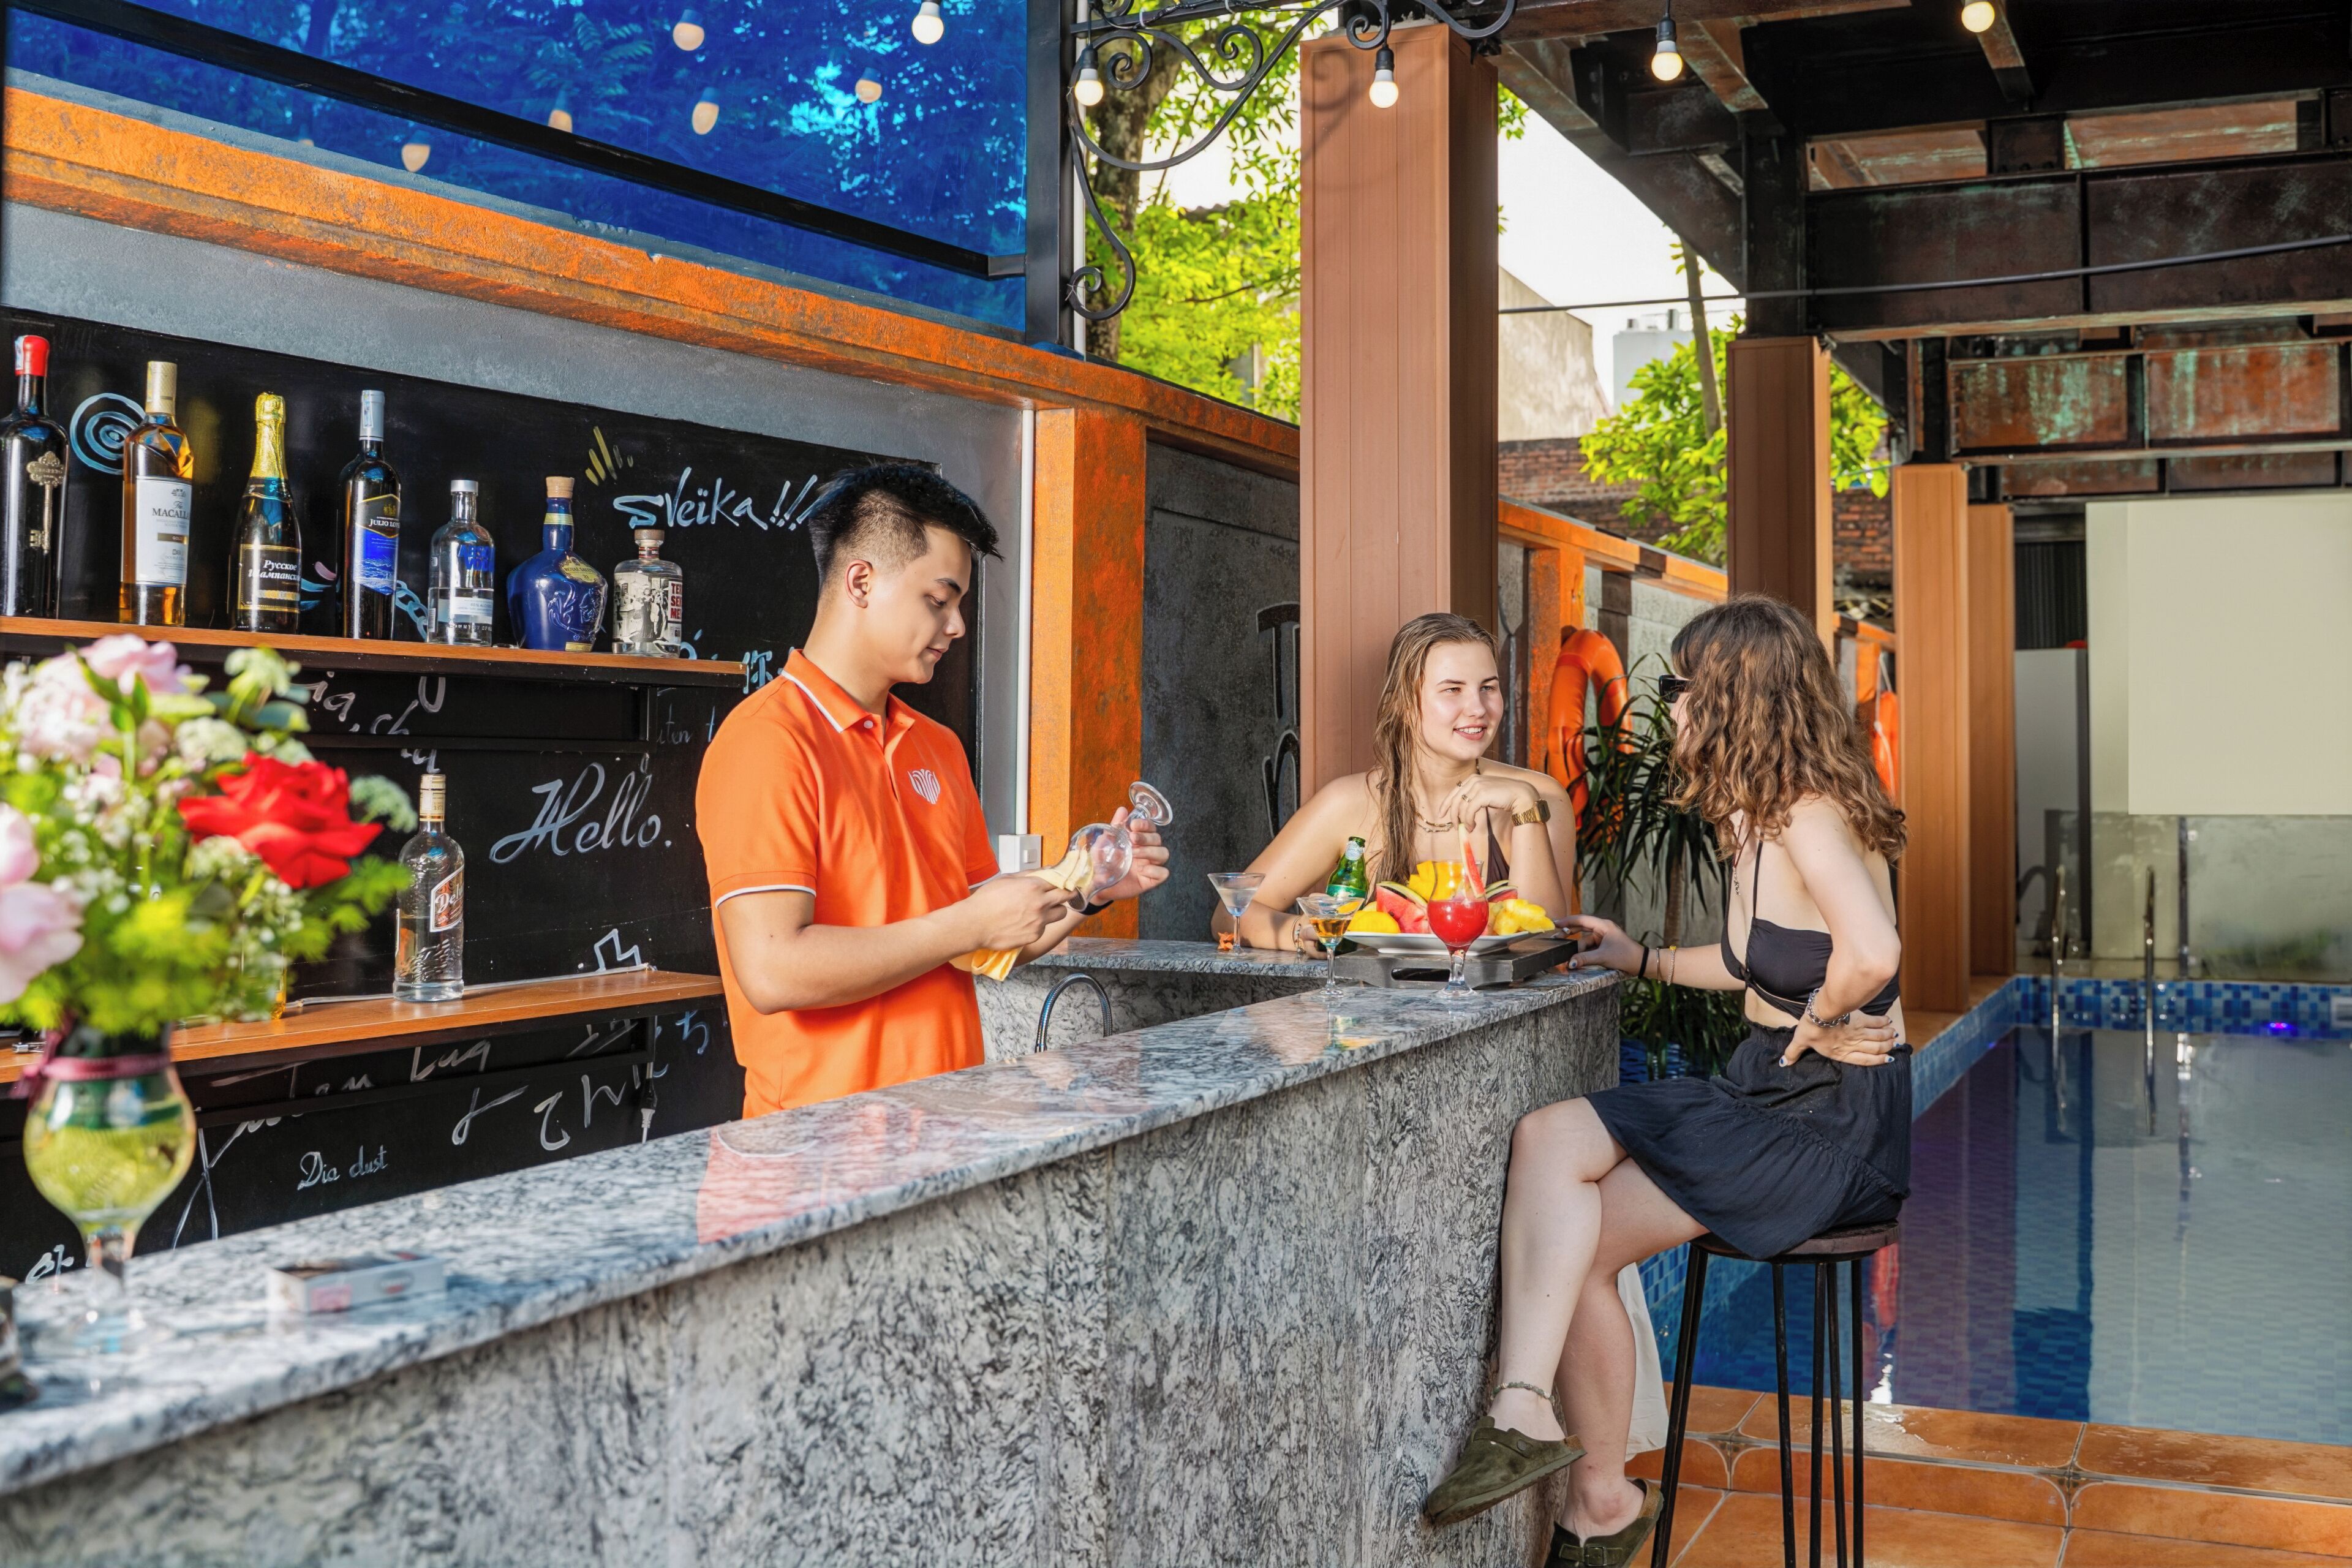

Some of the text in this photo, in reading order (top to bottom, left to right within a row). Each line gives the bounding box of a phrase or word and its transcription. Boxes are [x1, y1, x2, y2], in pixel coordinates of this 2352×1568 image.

[369, 518, 389, 527] JULIO
[263, 559, 298, 571] Русское
[490, 763, 672, 864] Hello.
[297, 1151, 341, 1191] Dia
